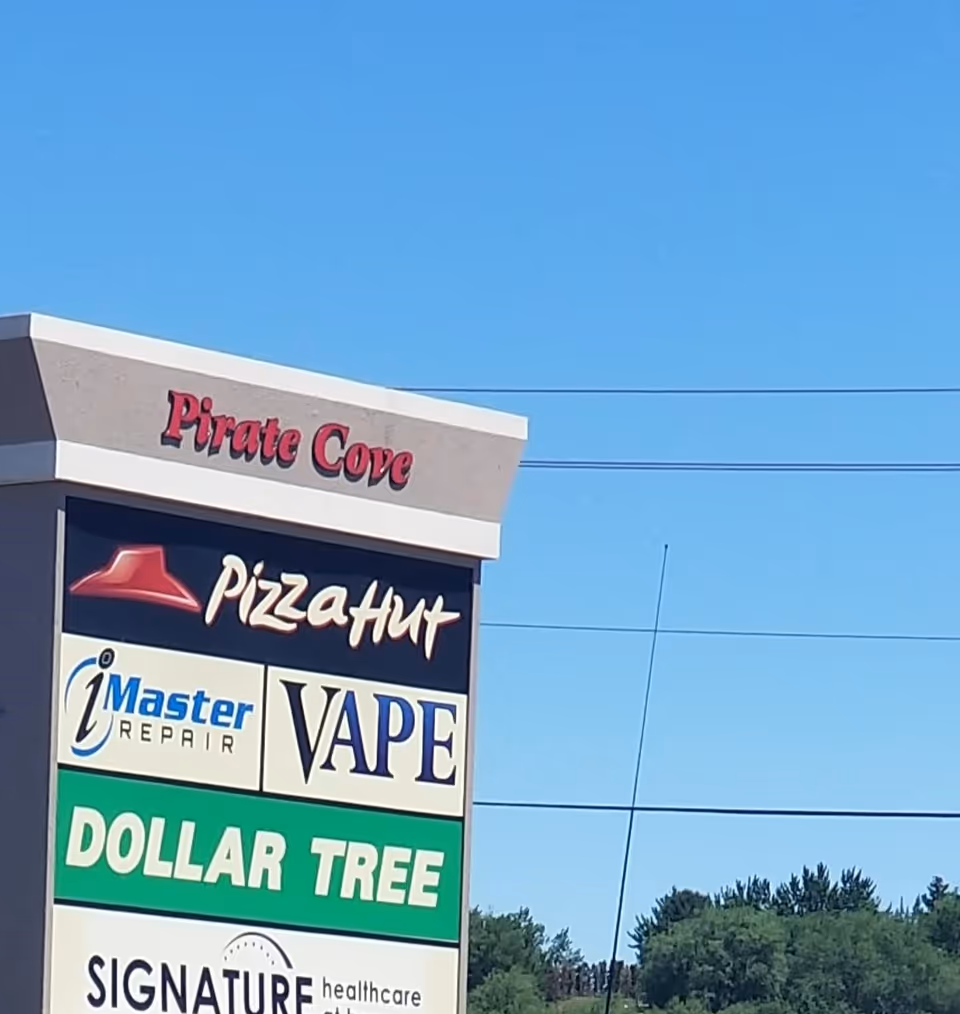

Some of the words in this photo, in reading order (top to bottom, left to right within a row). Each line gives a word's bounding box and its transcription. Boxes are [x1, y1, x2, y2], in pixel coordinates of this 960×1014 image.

[161, 389, 301, 467] Pirate
[312, 421, 414, 491] Cove
[120, 721, 235, 754] REPAIR
[279, 678, 457, 786] VAPE
[65, 805, 287, 891] DOLLAR
[310, 837, 445, 908] TREE
[322, 977, 421, 1007] healthcare
